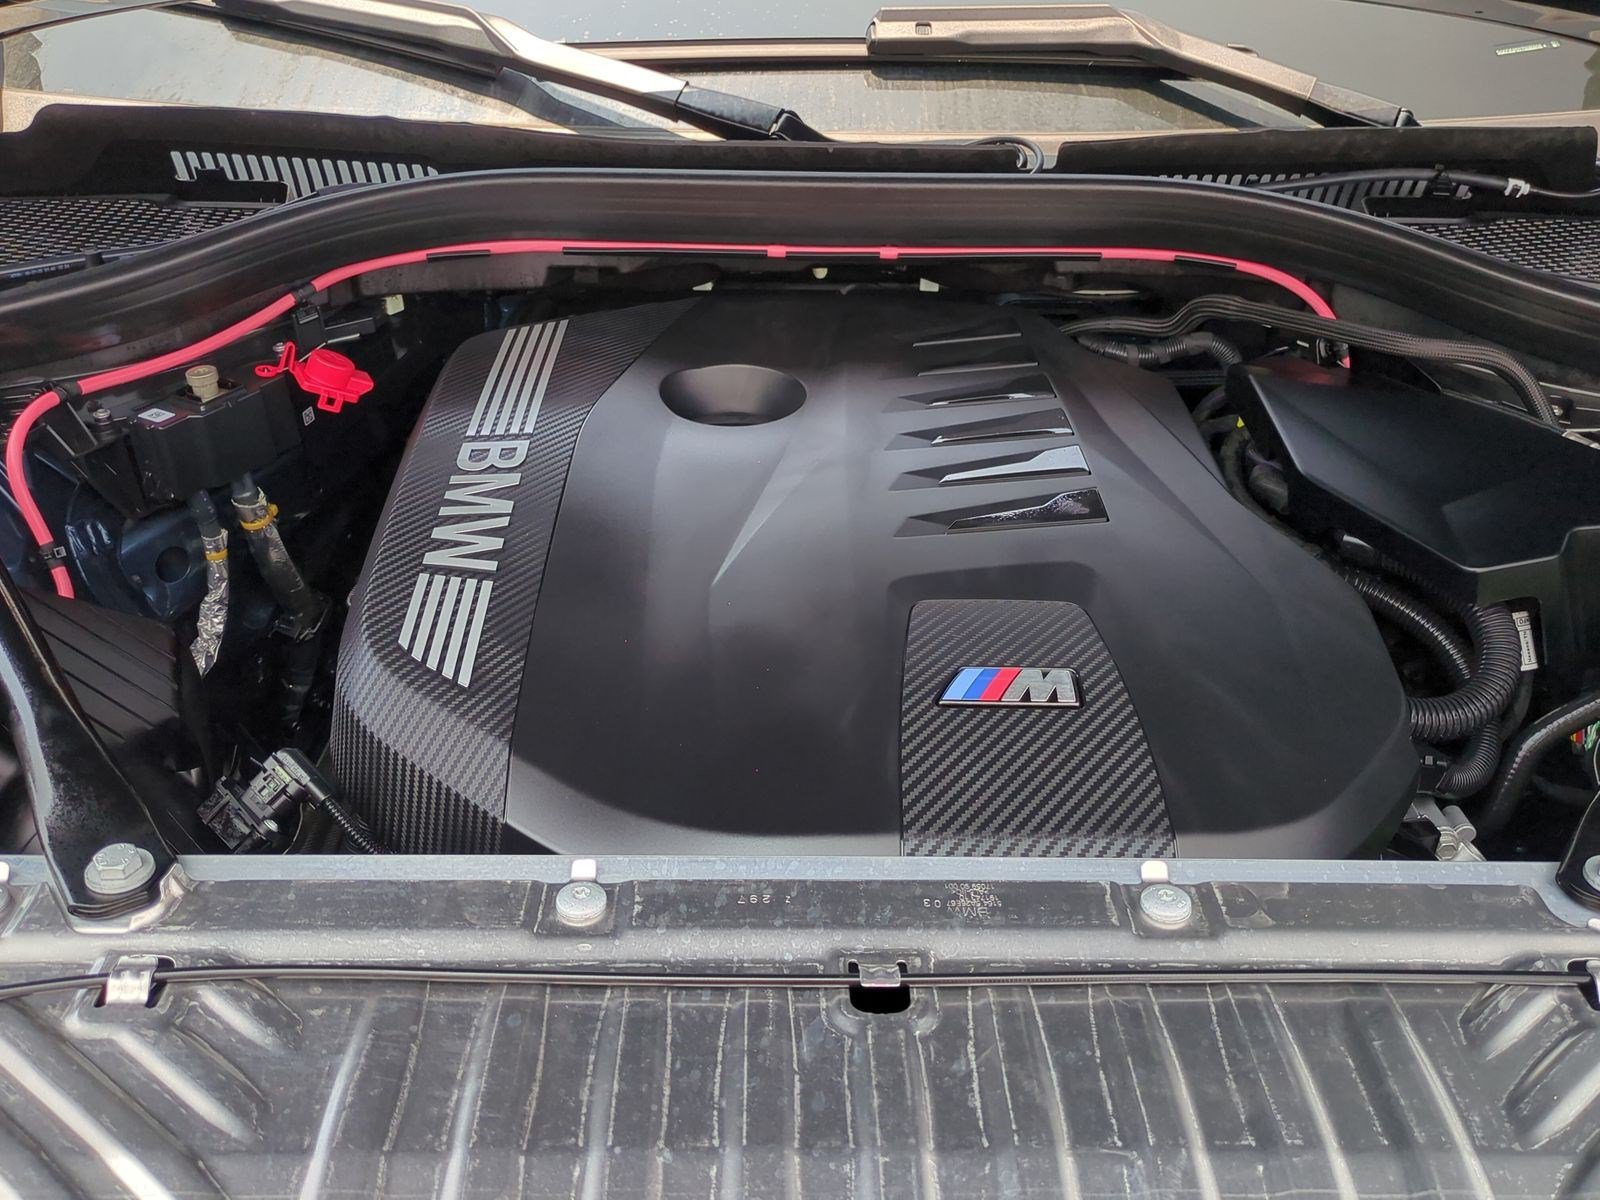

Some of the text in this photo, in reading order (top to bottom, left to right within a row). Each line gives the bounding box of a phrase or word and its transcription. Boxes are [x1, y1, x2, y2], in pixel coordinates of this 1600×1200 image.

[422, 440, 531, 572] BMW
[1000, 668, 1077, 702] M
[737, 894, 771, 904] 297
